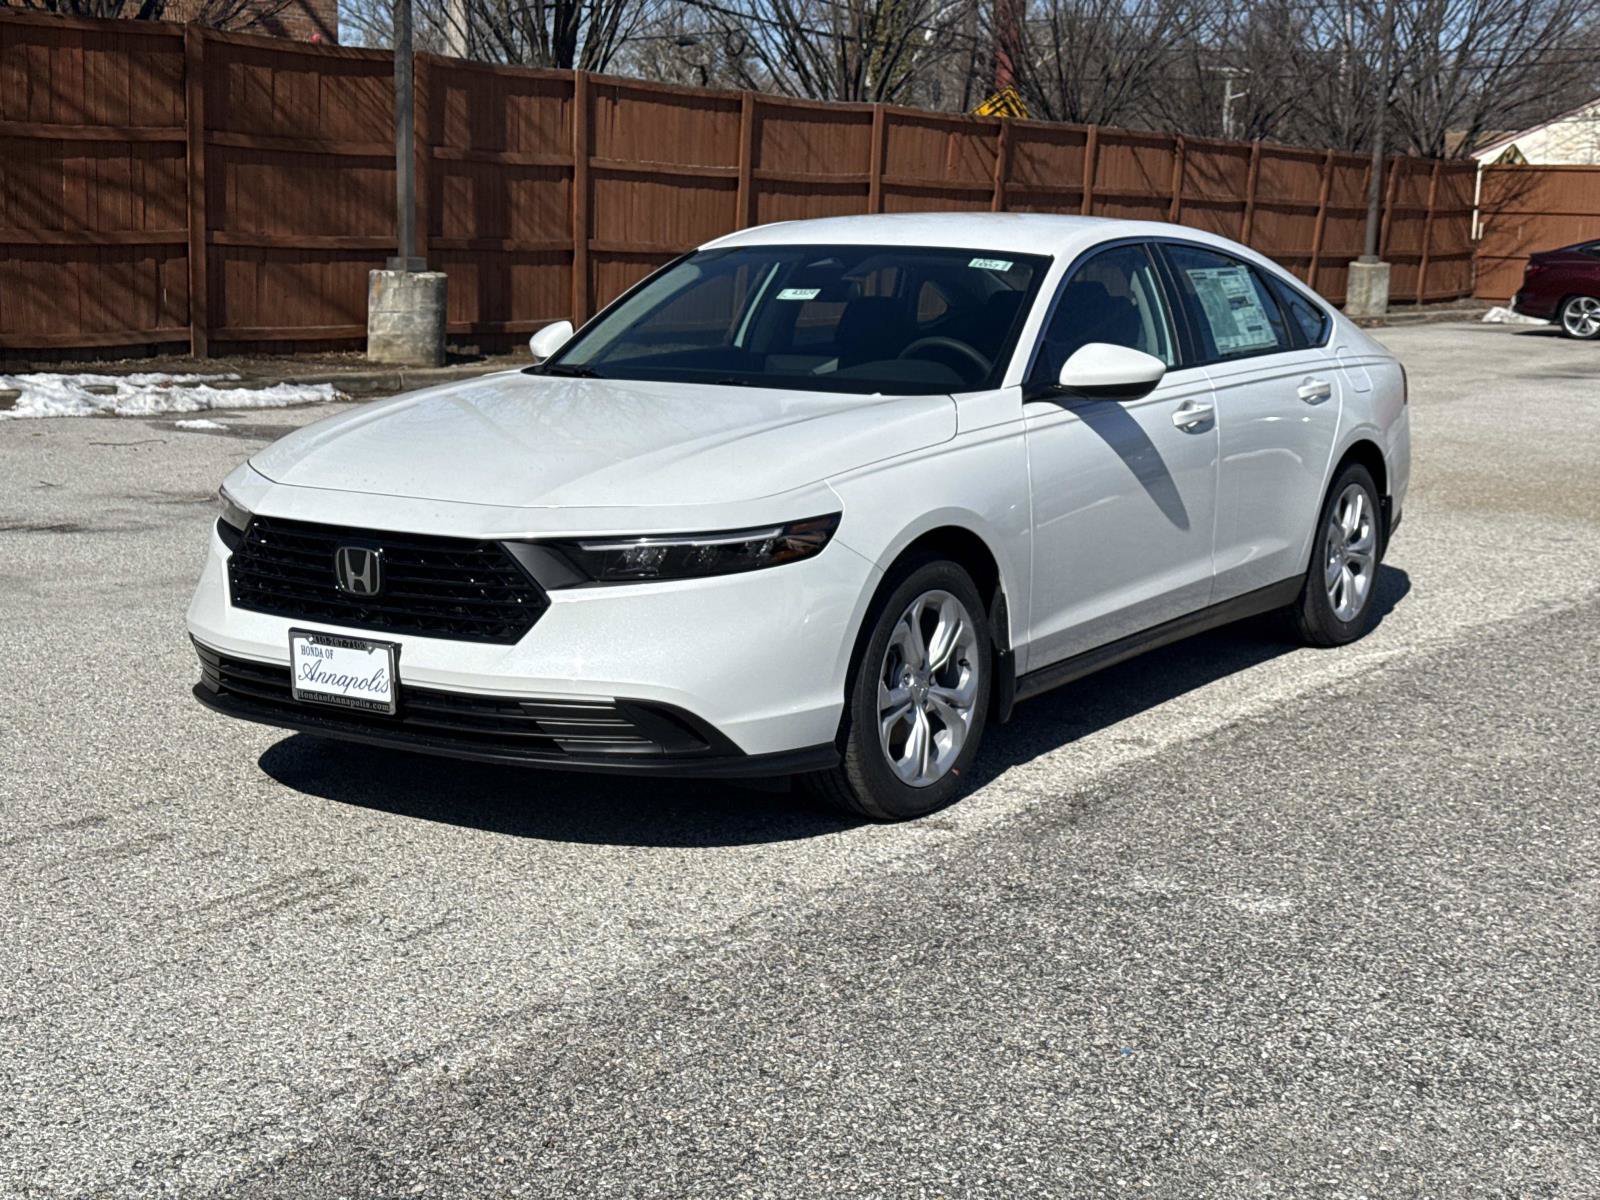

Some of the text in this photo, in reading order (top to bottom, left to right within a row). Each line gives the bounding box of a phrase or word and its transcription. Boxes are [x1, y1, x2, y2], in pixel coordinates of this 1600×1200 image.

[300, 644, 334, 660] HONDA OF
[298, 659, 390, 694] Annapolis
[297, 689, 390, 711] HondaofAnnapolis.com
